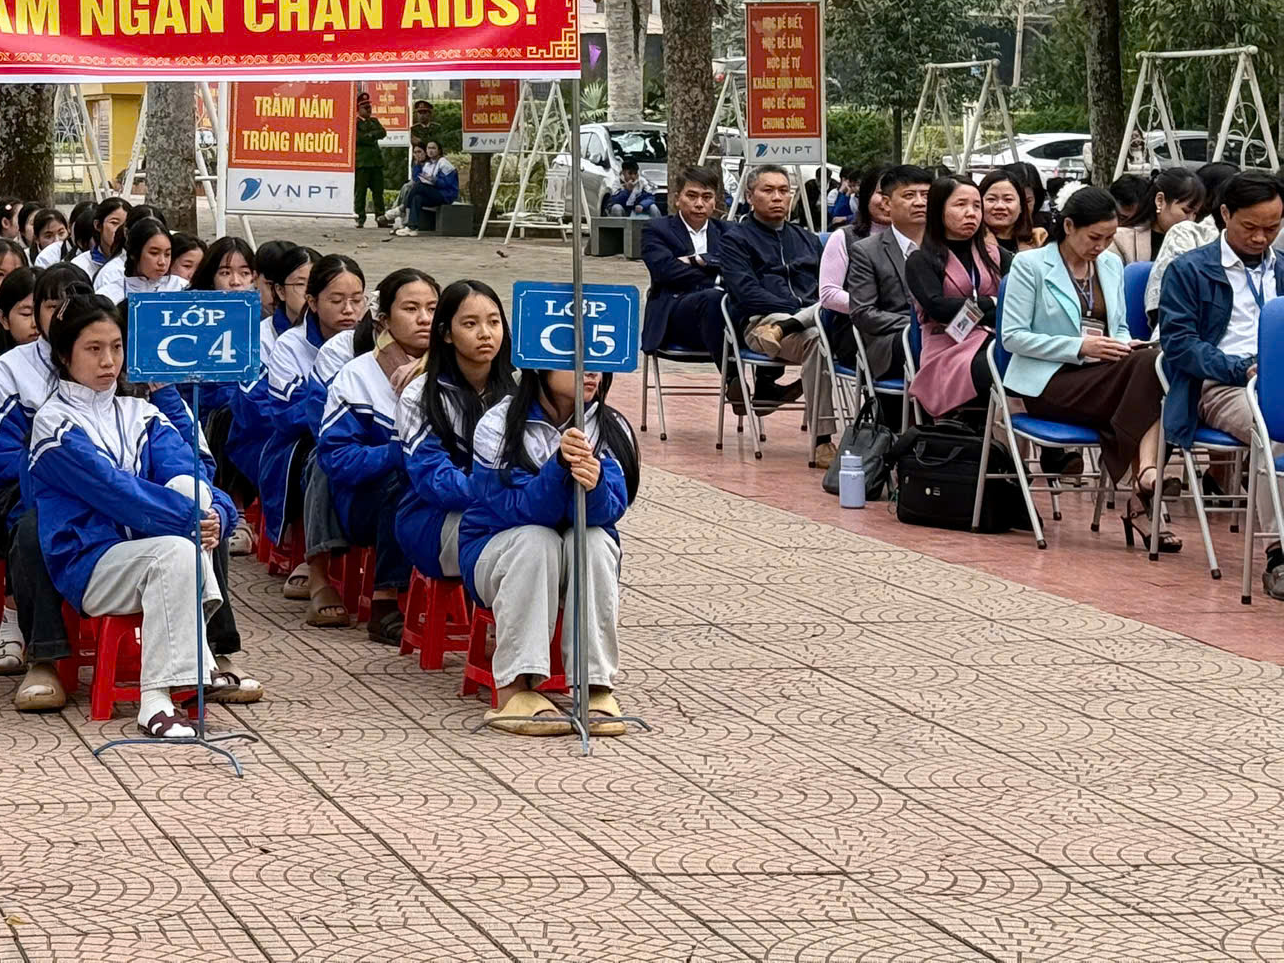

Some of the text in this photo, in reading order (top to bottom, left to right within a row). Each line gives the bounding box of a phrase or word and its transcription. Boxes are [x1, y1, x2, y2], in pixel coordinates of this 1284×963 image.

[254, 93, 334, 119] TRĂM NĂM
[294, 128, 343, 153] NGƯỜI.
[770, 145, 812, 154] VNPT
[267, 184, 338, 199] VNPT
[161, 304, 226, 327] LỚP
